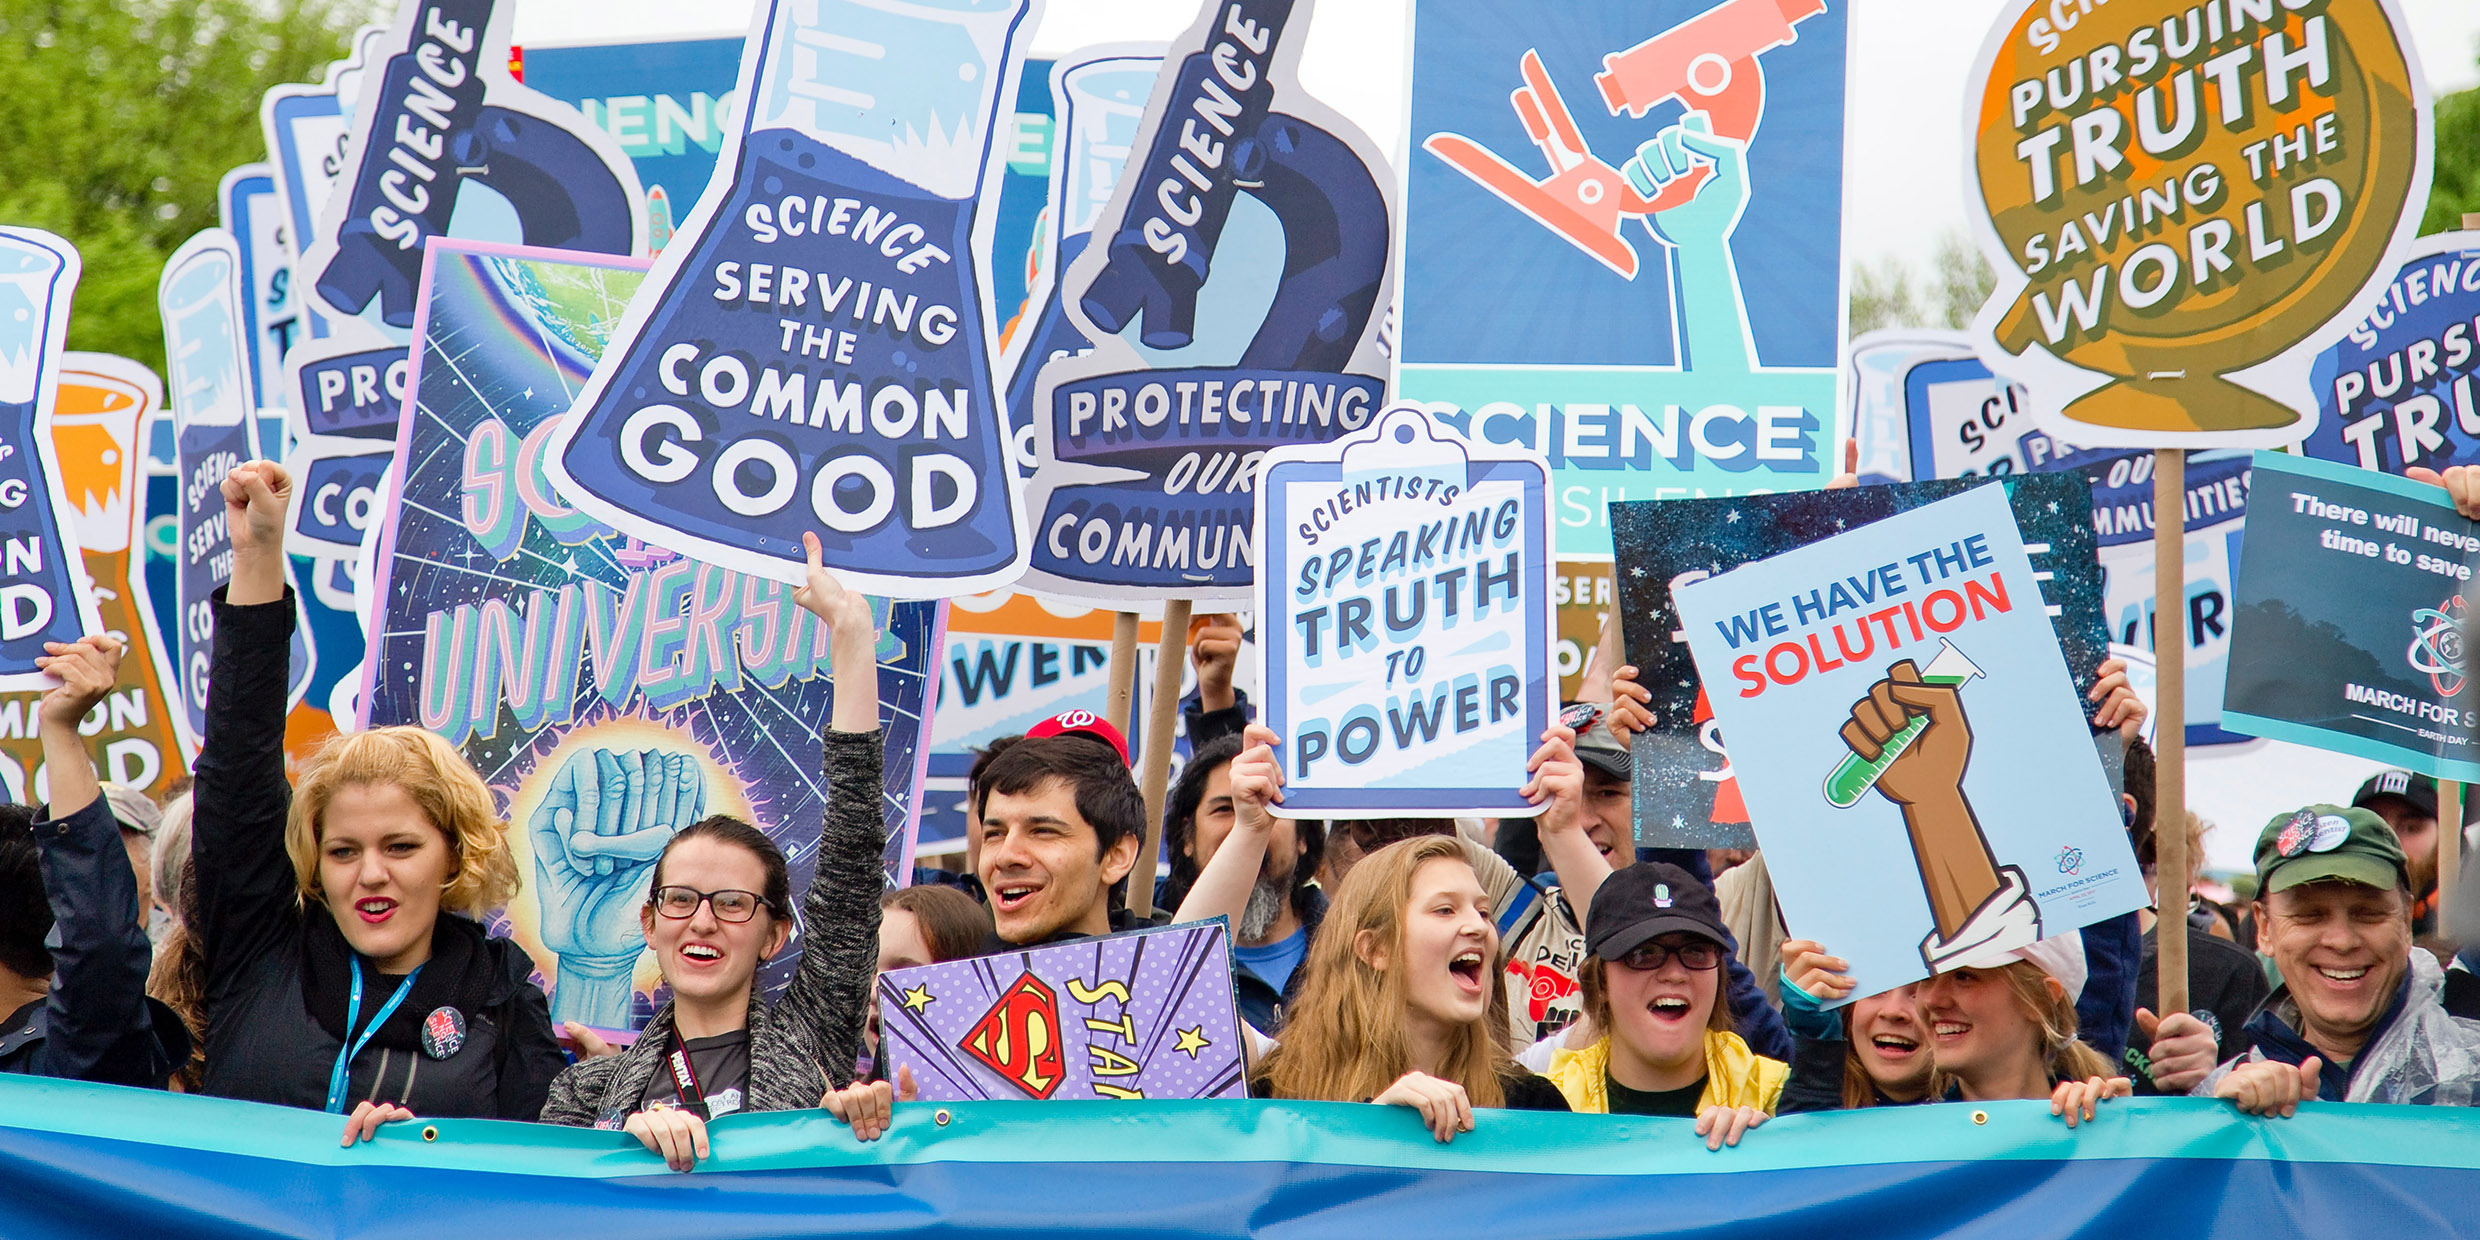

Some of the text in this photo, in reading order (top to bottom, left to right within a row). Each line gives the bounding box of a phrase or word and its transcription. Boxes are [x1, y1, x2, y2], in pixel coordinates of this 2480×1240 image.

[370, 6, 474, 250] SCIENCE
[1143, 2, 1270, 265] SCIENCE
[2017, 15, 2330, 204] TRUTH
[745, 194, 951, 276] SCIENCE
[2026, 114, 2338, 274] SAVING THE
[2032, 178, 2342, 346] WORLD
[713, 261, 958, 346] SERVING
[779, 318, 858, 366] THE
[659, 343, 969, 441] COMMON
[1070, 379, 1371, 438] PROTECTING
[620, 404, 978, 533] GOOD
[1297, 499, 1518, 596] SPEAKING
[1299, 476, 1459, 546] SCIENTISTS
[2291, 492, 2480, 553] There will neve
[1715, 602, 1789, 650] WE
[1793, 562, 1906, 626] HAVE
[1907, 533, 1994, 585] THE
[2321, 528, 2472, 581] time to save
[420, 558, 880, 729] UNIVERSA
[1296, 551, 1519, 658] TRUTH
[1732, 572, 2012, 698] SOLUTION
[1388, 646, 1425, 684] TO
[2346, 683, 2416, 716] MARCH
[2419, 701, 2459, 726] FOR
[1298, 674, 1520, 779] POWER
[2418, 728, 2469, 746] EARTH DAY
[2278, 812, 2315, 842] SCIENCE
[2038, 885, 2067, 898] MARCH
[2068, 879, 2084, 889] FOR
[2085, 869, 2119, 884] SCIENCE
[429, 1017, 445, 1058] SILENCE
[438, 1023, 450, 1044] NOT
[442, 1010, 460, 1055] SCIENCE
[670, 1050, 694, 1090] PENTAX
